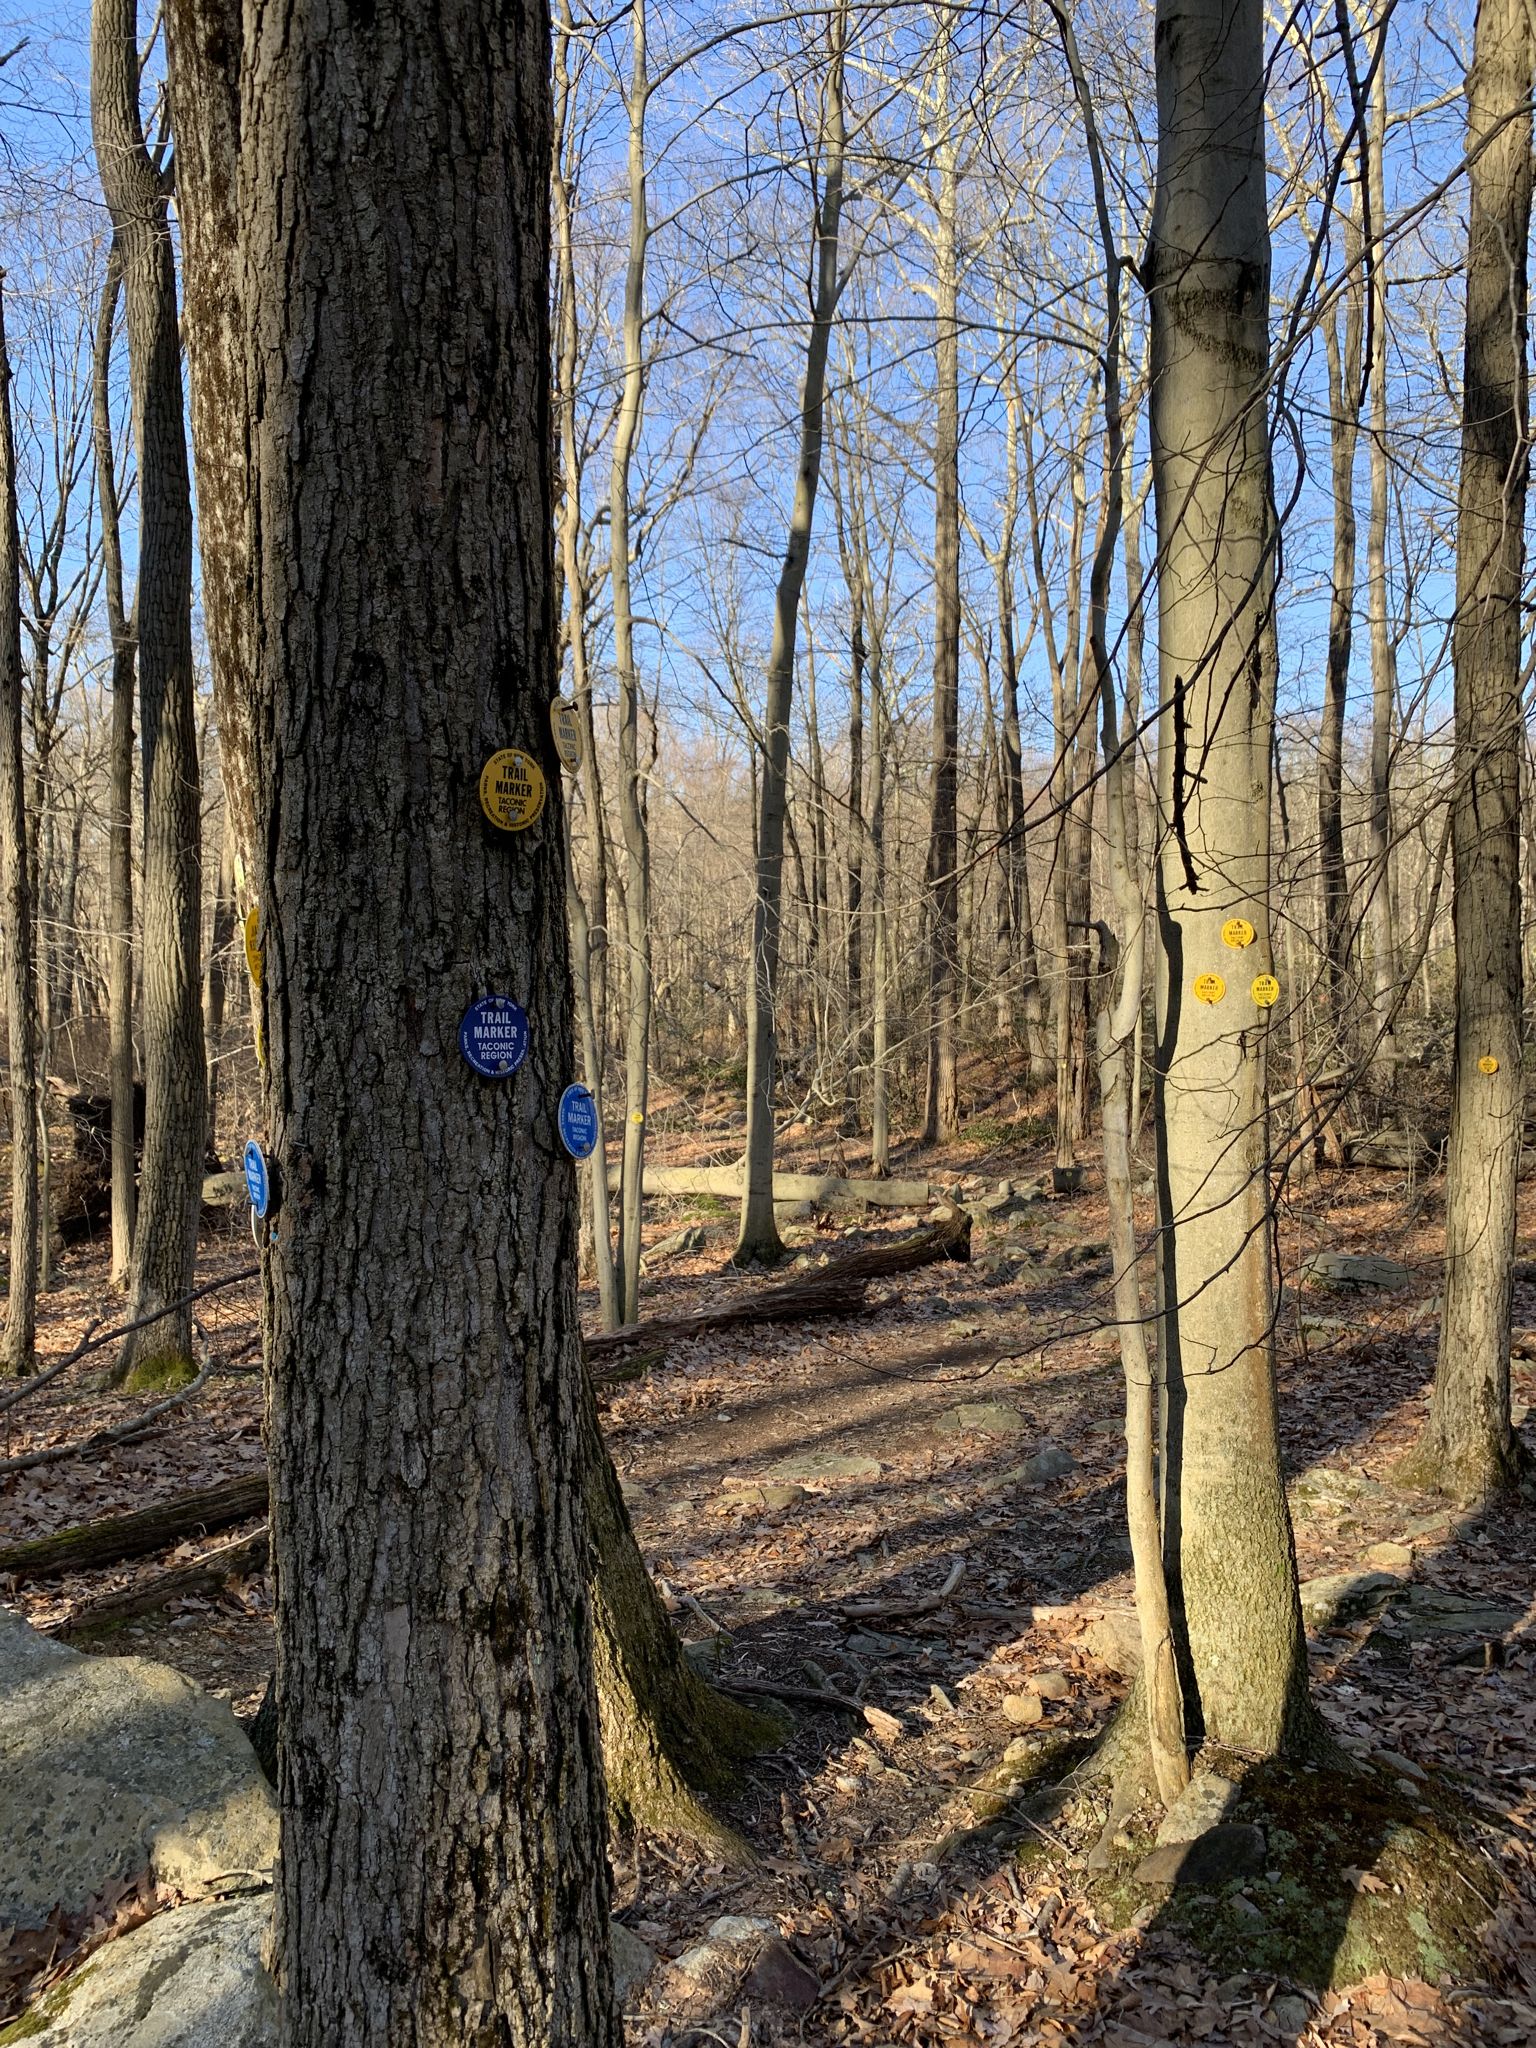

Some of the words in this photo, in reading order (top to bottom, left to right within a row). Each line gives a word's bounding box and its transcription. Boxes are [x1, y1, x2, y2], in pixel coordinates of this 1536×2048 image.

[502, 765, 529, 782] TRAIL
[495, 780, 533, 798] MARKER
[498, 796, 527, 807] TACONIC
[498, 805, 526, 815] REGION
[480, 1011, 512, 1024] TRAIL
[473, 1026, 518, 1039] MARKER
[477, 1042, 515, 1051] TACONIC
[480, 1051, 513, 1060] REGION
[571, 1100, 587, 1113] TRAIL
[567, 1112, 592, 1126] MARKER
